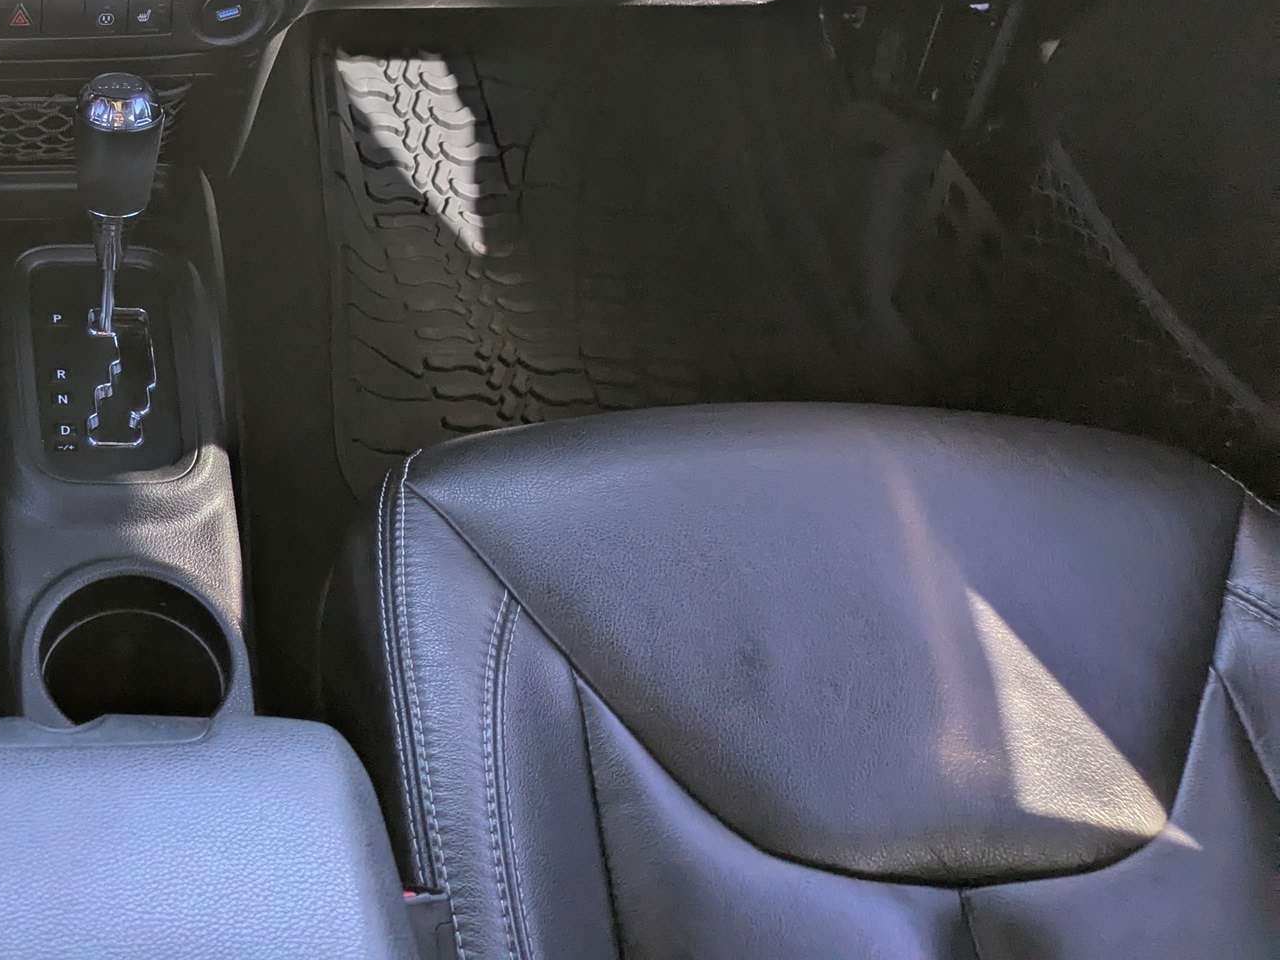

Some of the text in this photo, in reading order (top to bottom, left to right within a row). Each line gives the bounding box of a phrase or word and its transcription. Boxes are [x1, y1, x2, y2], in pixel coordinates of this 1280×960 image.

[53, 314, 62, 323] P
[56, 369, 66, 380] R
[58, 394, 68, 404] N
[61, 425, 71, 435] D
